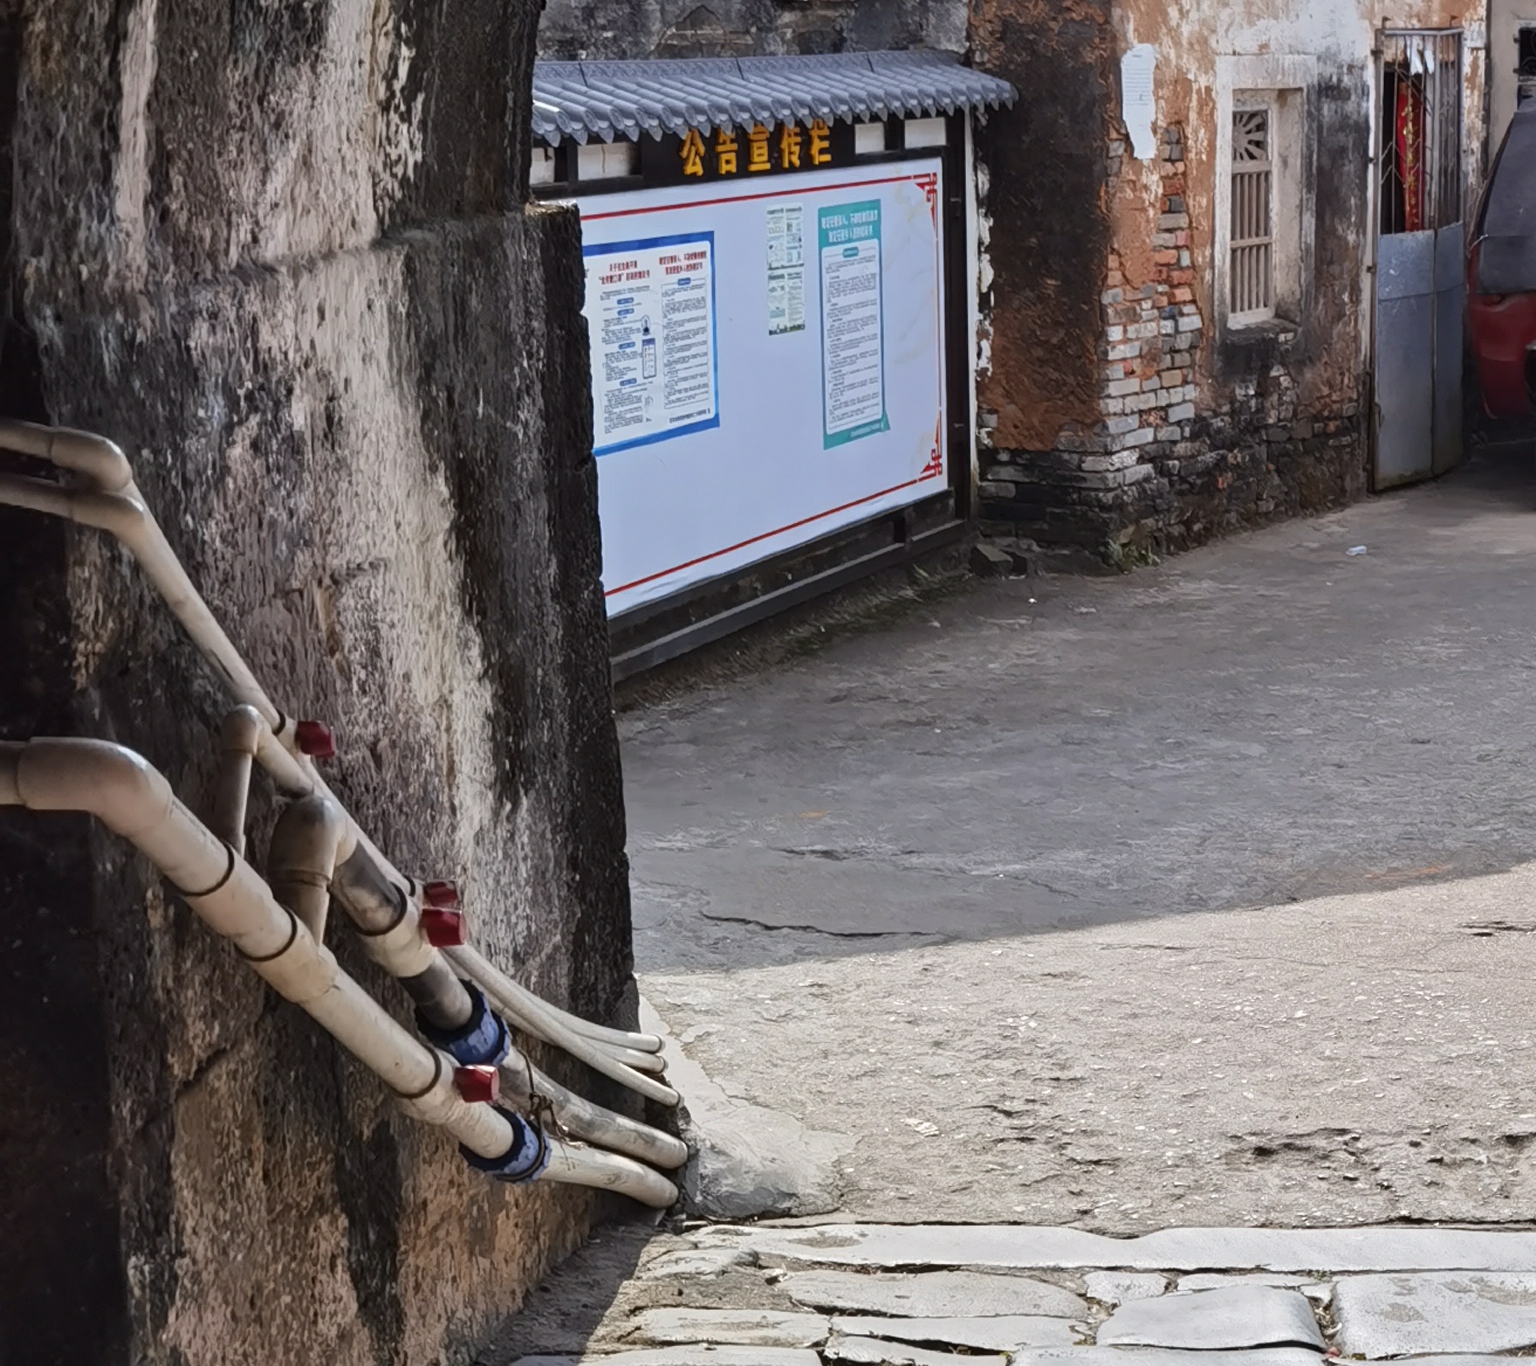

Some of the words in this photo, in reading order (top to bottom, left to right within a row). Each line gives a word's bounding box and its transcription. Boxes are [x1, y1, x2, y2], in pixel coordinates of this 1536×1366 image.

[679, 118, 832, 176] 公告宣传栏
